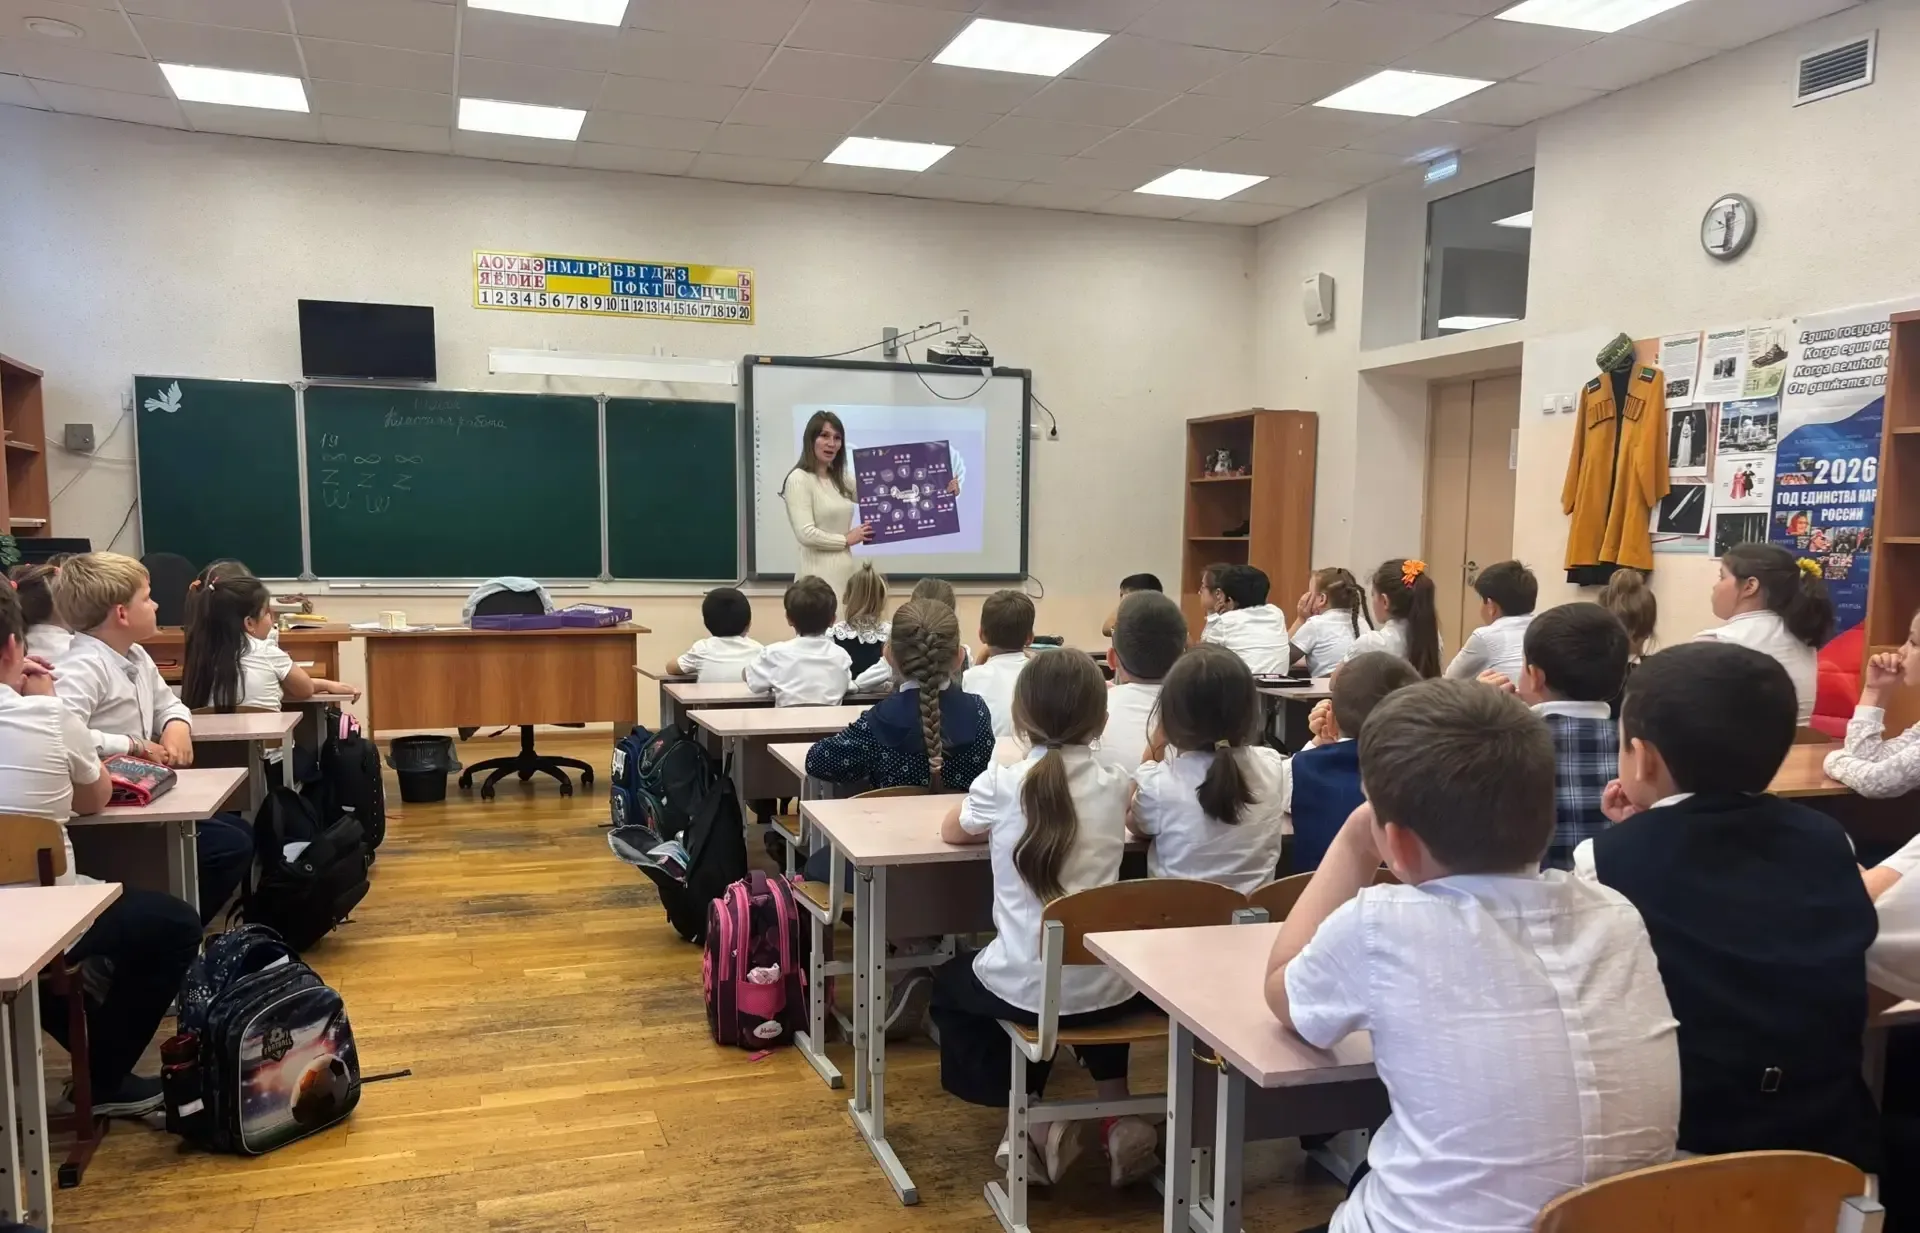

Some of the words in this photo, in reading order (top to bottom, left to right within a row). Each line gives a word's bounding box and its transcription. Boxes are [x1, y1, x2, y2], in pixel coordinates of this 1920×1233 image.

[482, 291, 489, 303] 1
[496, 292, 504, 304] 2
[510, 292, 518, 305] 3
[523, 293, 532, 305] 4
[539, 293, 547, 307] 5
[552, 294, 561, 307] 6
[566, 295, 575, 308] 7
[580, 296, 589, 309] 8
[594, 296, 602, 309] 9
[606, 297, 617, 311] 10
[620, 298, 629, 311] 11
[633, 299, 644, 312] 12
[646, 300, 657, 313] 13
[660, 301, 670, 314] 14
[674, 302, 684, 315] 15
[686, 303, 697, 316] 16
[700, 304, 710, 317] 17
[713, 305, 724, 318] 18
[726, 306, 737, 318] 19
[739, 306, 750, 319] 20
[1800, 329, 1836, 344] Едино
[1803, 346, 1839, 360] Когда
[1841, 340, 1872, 356] един
[1793, 363, 1831, 377] Когда
[1832, 355, 1884, 373] великой
[1788, 382, 1807, 394] Он
[1807, 376, 1873, 395] движется
[1813, 456, 1878, 484] 2026
[1777, 491, 1799, 506] ГОД
[1800, 490, 1857, 506] ЕДИНСТВА
[1821, 508, 1864, 521] РОССИИ
